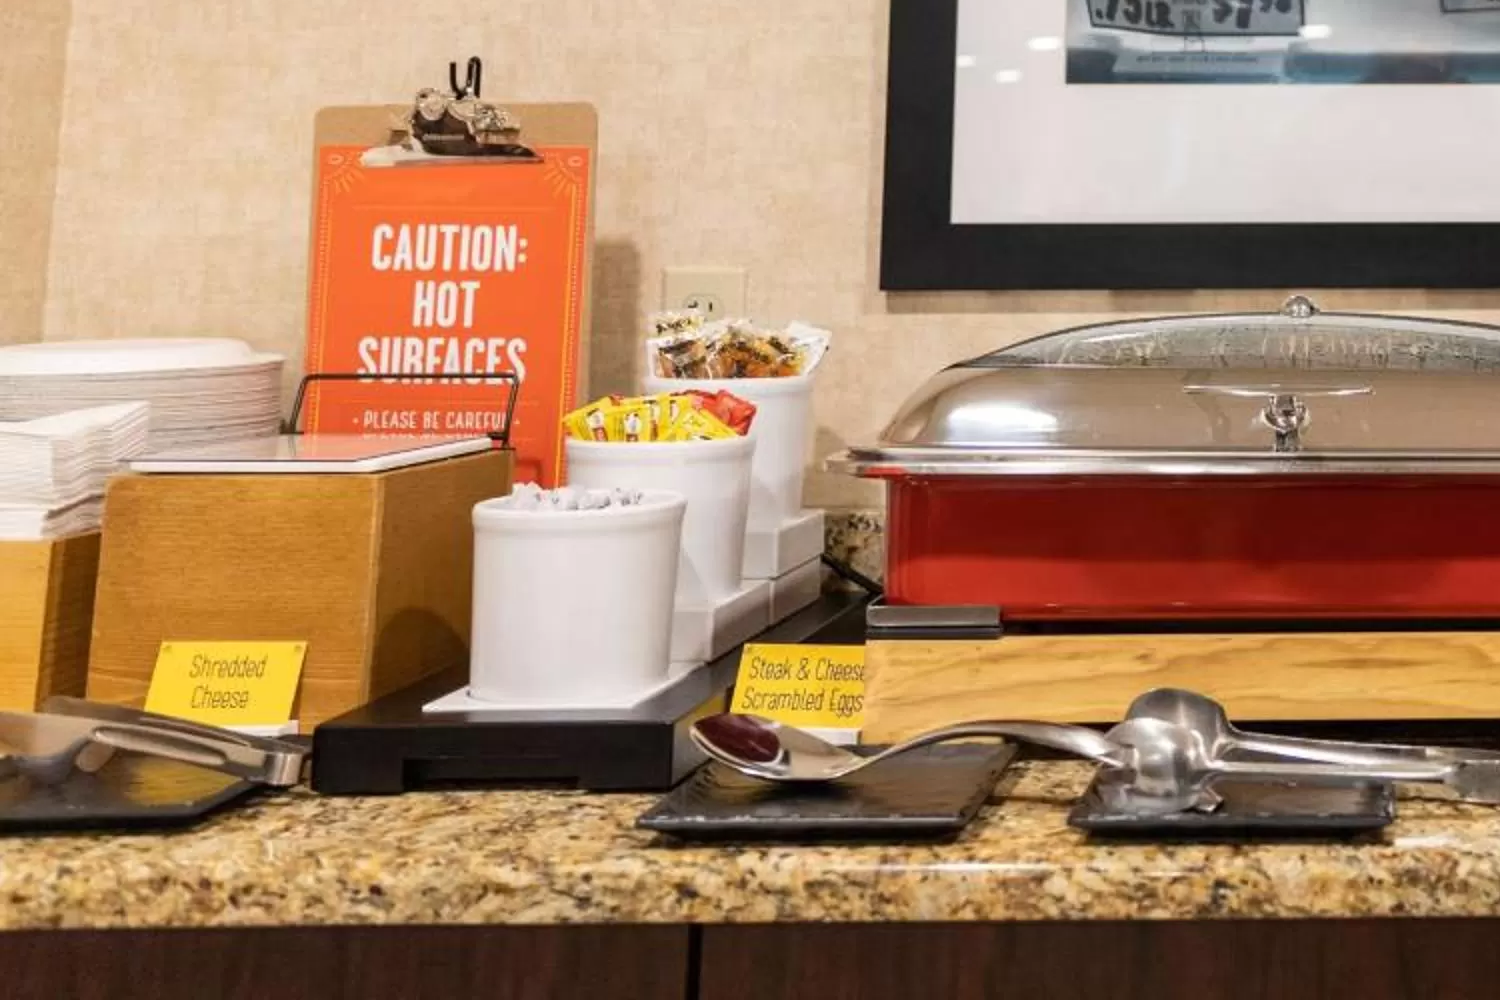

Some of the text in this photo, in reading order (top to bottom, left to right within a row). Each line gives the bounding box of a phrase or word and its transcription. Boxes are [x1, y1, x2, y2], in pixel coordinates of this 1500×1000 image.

[372, 223, 528, 272] CAUTION:
[412, 280, 481, 329] HOT
[356, 335, 527, 385] SURFACES
[363, 410, 417, 428] PLEASE
[423, 411, 440, 429] BE
[189, 653, 268, 679] Shredded
[748, 656, 792, 681] Steak
[796, 658, 811, 681] &
[190, 685, 249, 709] Cheese
[741, 686, 864, 719] Scrambled Eggs
